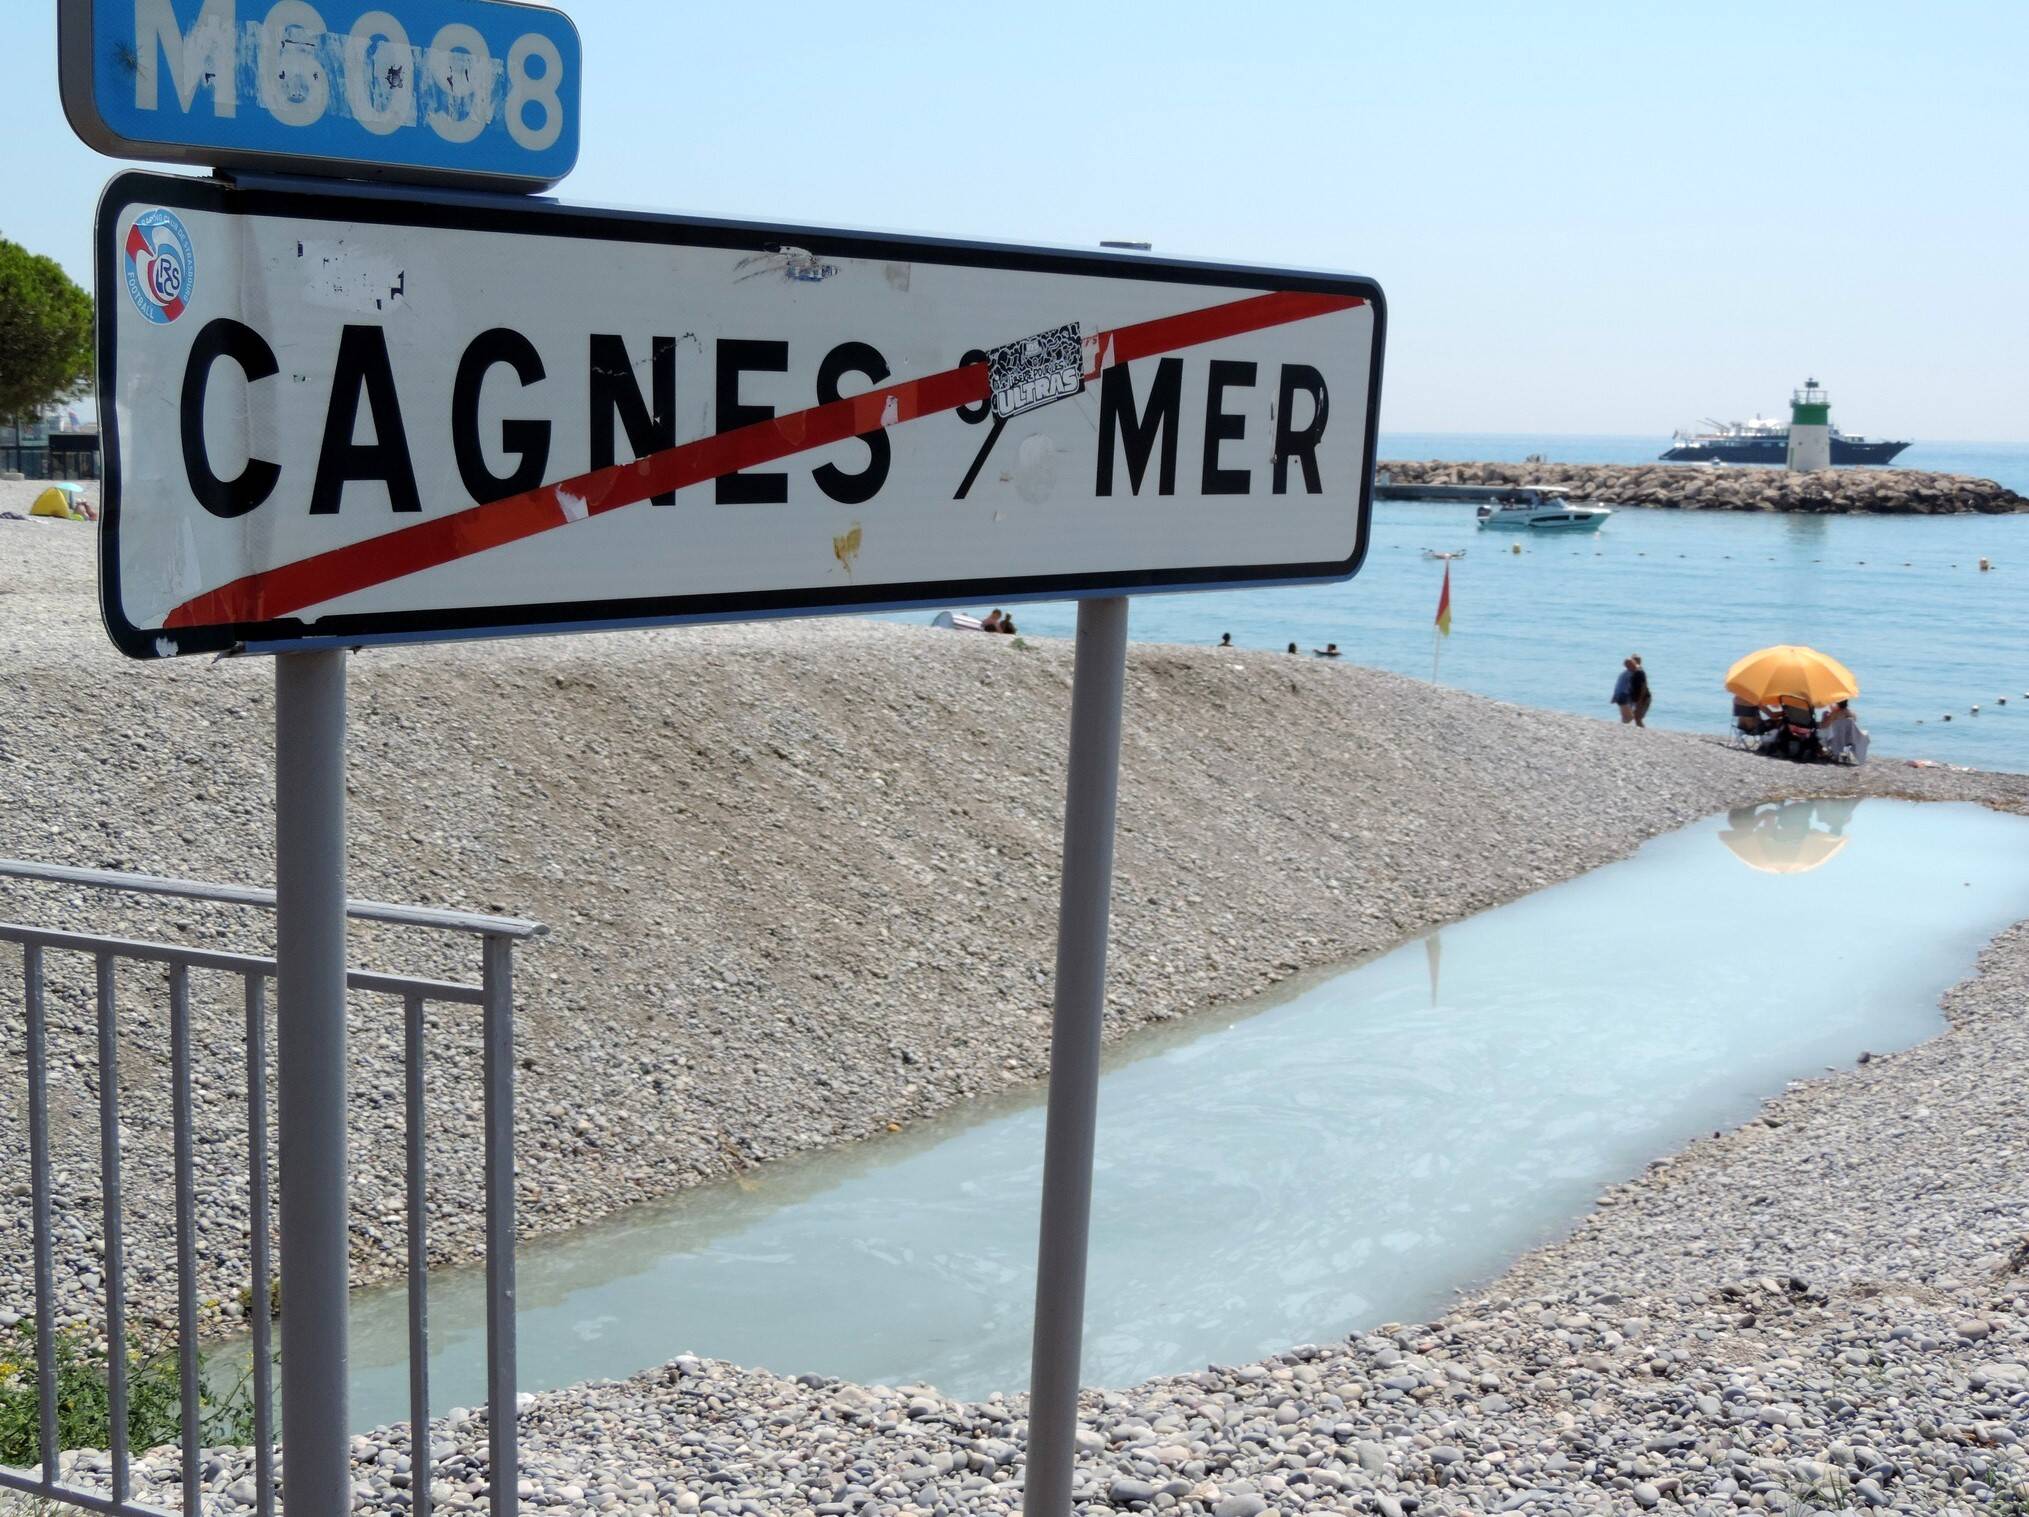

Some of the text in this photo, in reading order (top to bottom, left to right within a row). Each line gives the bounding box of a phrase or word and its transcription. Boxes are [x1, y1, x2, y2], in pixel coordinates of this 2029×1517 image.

[135, 0, 563, 152] M6098
[128, 271, 154, 319] FOOTBALL
[180, 317, 892, 518] CAGNES
[1096, 357, 1329, 497] MER
[998, 366, 1077, 416] ULTRAS
